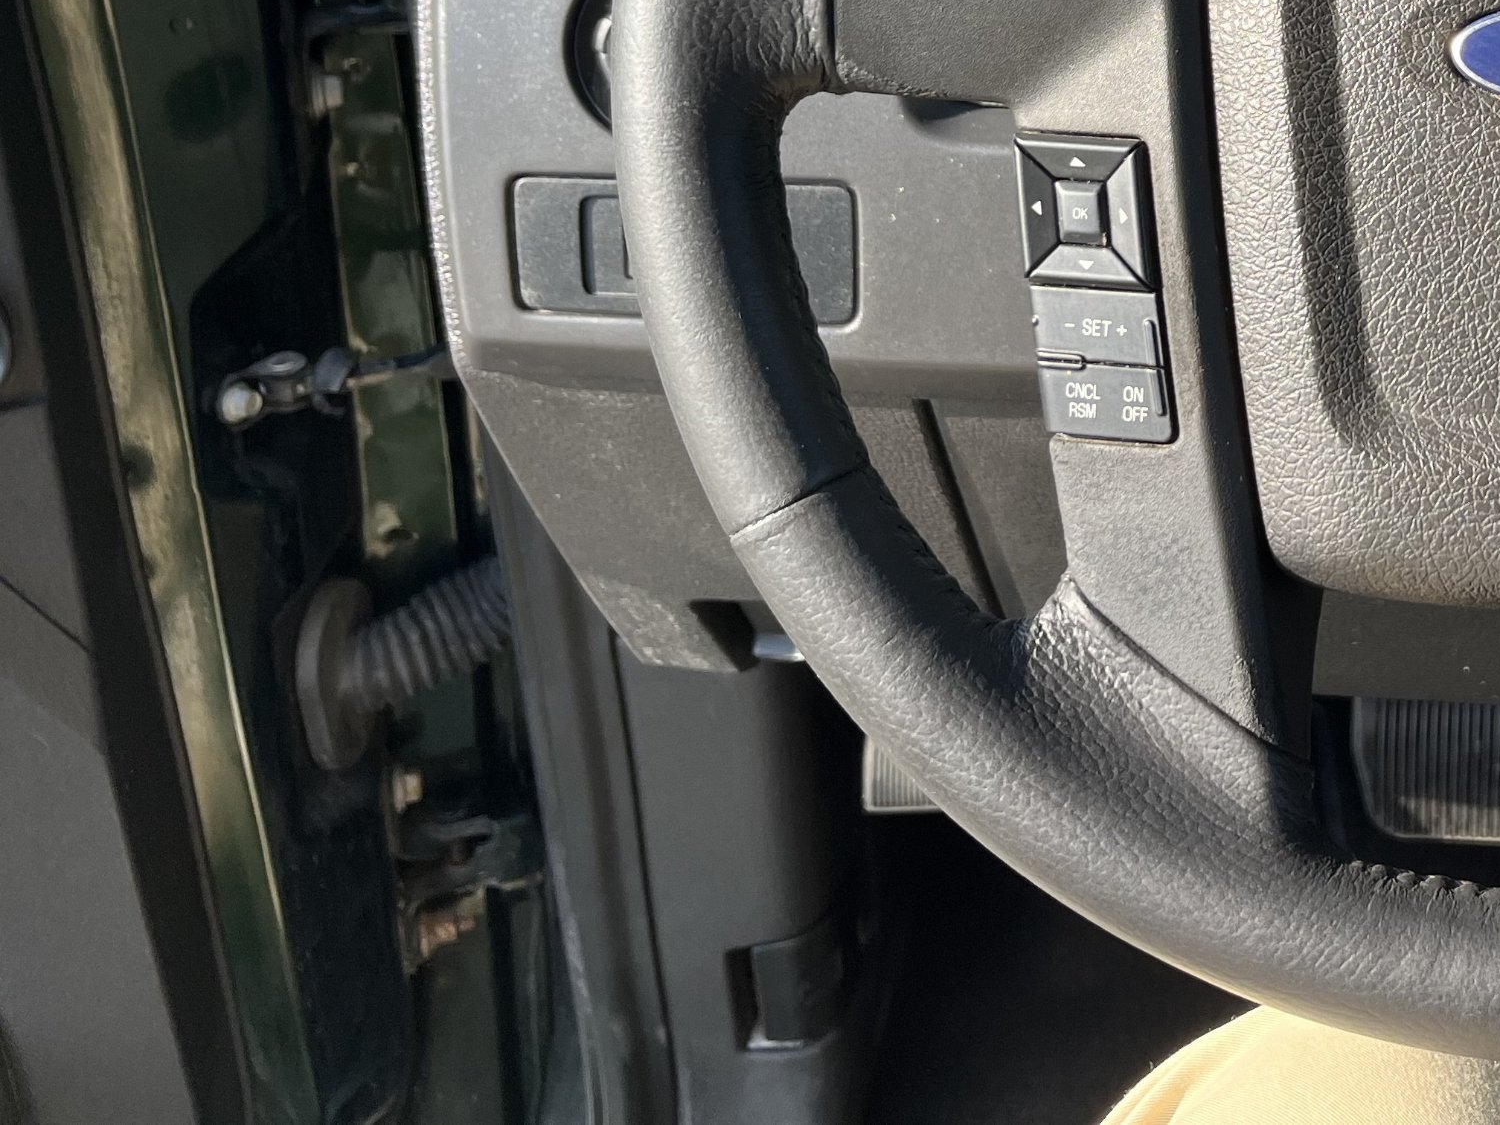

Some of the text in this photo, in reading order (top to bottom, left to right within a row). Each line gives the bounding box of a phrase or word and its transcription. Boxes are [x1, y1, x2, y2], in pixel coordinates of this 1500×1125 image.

[1072, 207, 1089, 220] OK
[1081, 319, 1111, 337] SET
[1065, 382, 1101, 401] CNCL
[1123, 386, 1144, 403] ON
[1069, 402, 1097, 419] RSM
[1123, 405, 1148, 423] OFF
